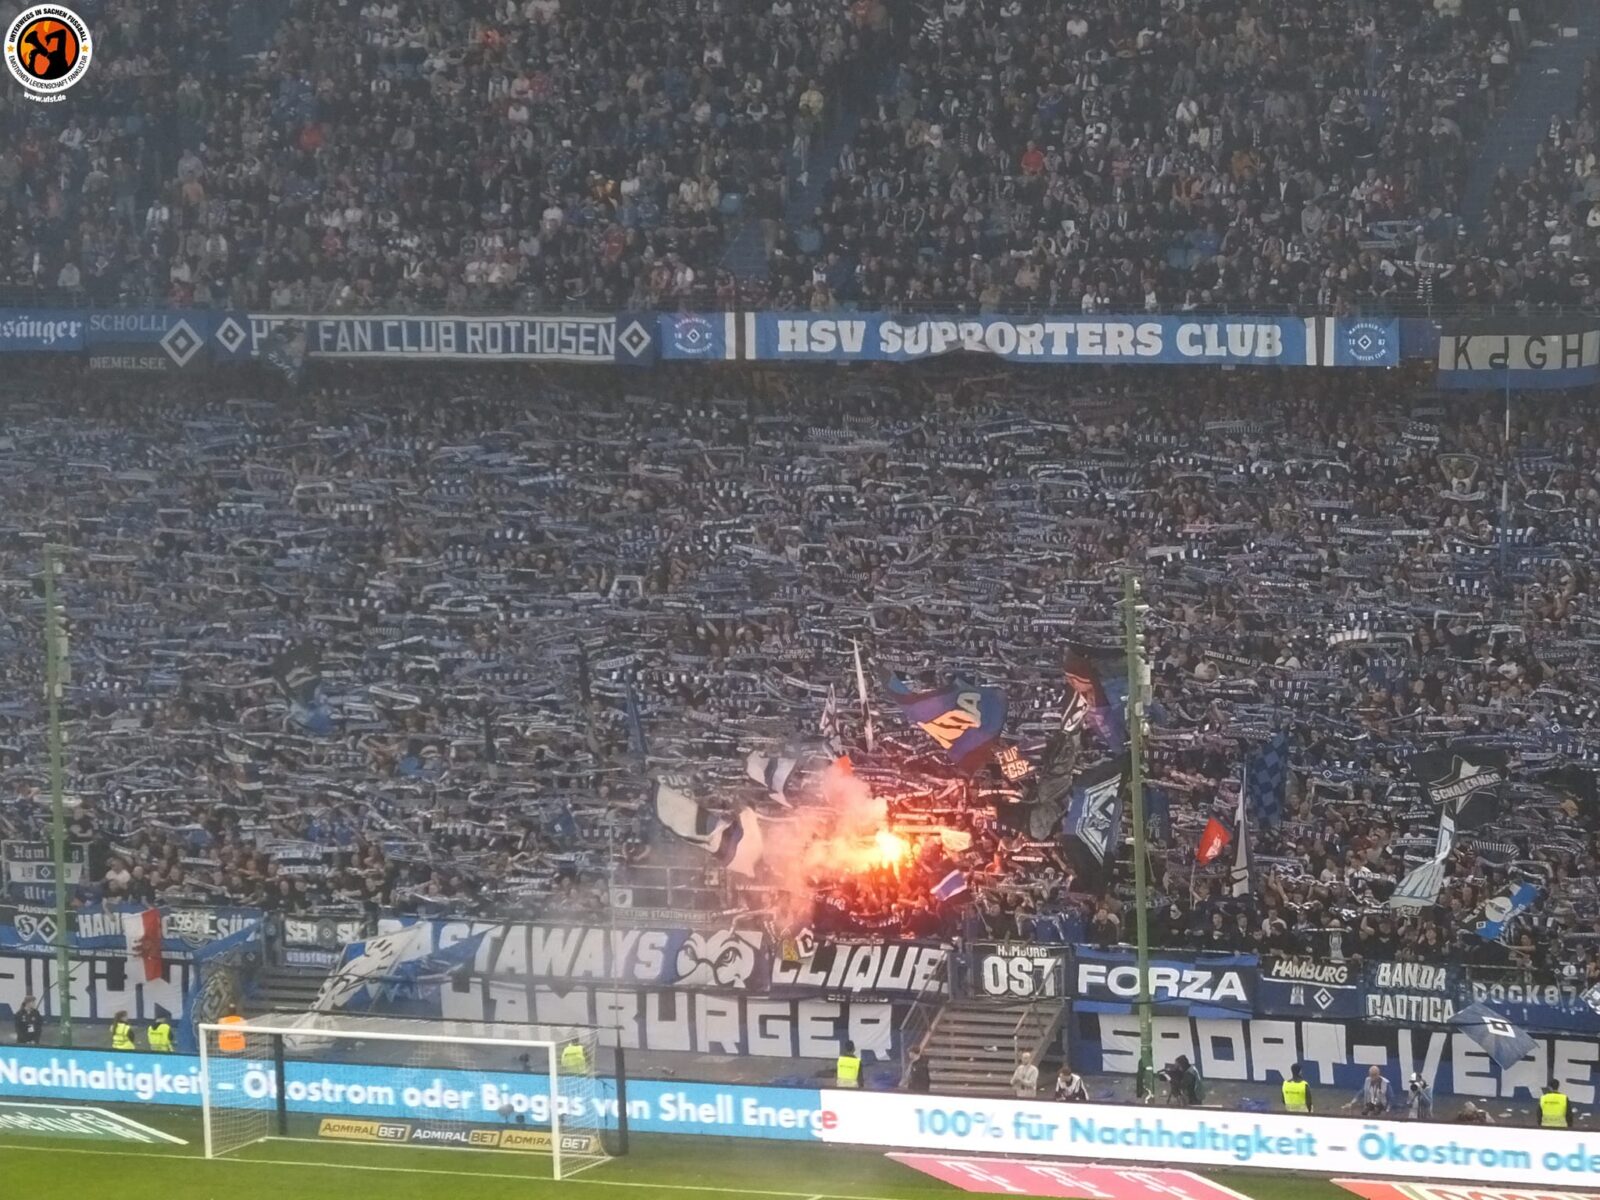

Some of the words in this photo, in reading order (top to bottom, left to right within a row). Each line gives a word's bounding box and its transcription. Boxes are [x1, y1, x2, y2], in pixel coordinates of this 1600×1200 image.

[0, 315, 82, 345] sänger
[89, 314, 168, 332] SCHOLLI
[319, 321, 371, 352] FAN
[382, 321, 456, 353] CLUB
[466, 321, 615, 355] ROTHOSEN
[777, 320, 866, 352] HSV
[879, 320, 1163, 356] SUPPORTERS
[1176, 322, 1283, 357] CLUB
[89, 356, 167, 371] DIEMELSEE
[1078, 964, 1248, 1001] FORZA
[1271, 960, 1349, 983] HAMBURG
[1376, 962, 1447, 991] BANDA
[243, 1062, 394, 1106] Ökostrom
[403, 1079, 473, 1109] oder
[482, 1083, 583, 1122] Biogas
[659, 1092, 734, 1124] Shell
[915, 1108, 1003, 1139] 100%
[1013, 1111, 1058, 1141] für
[1070, 1116, 1318, 1161] Nachhaltigkeit
[1358, 1124, 1531, 1170] Ökostrom
